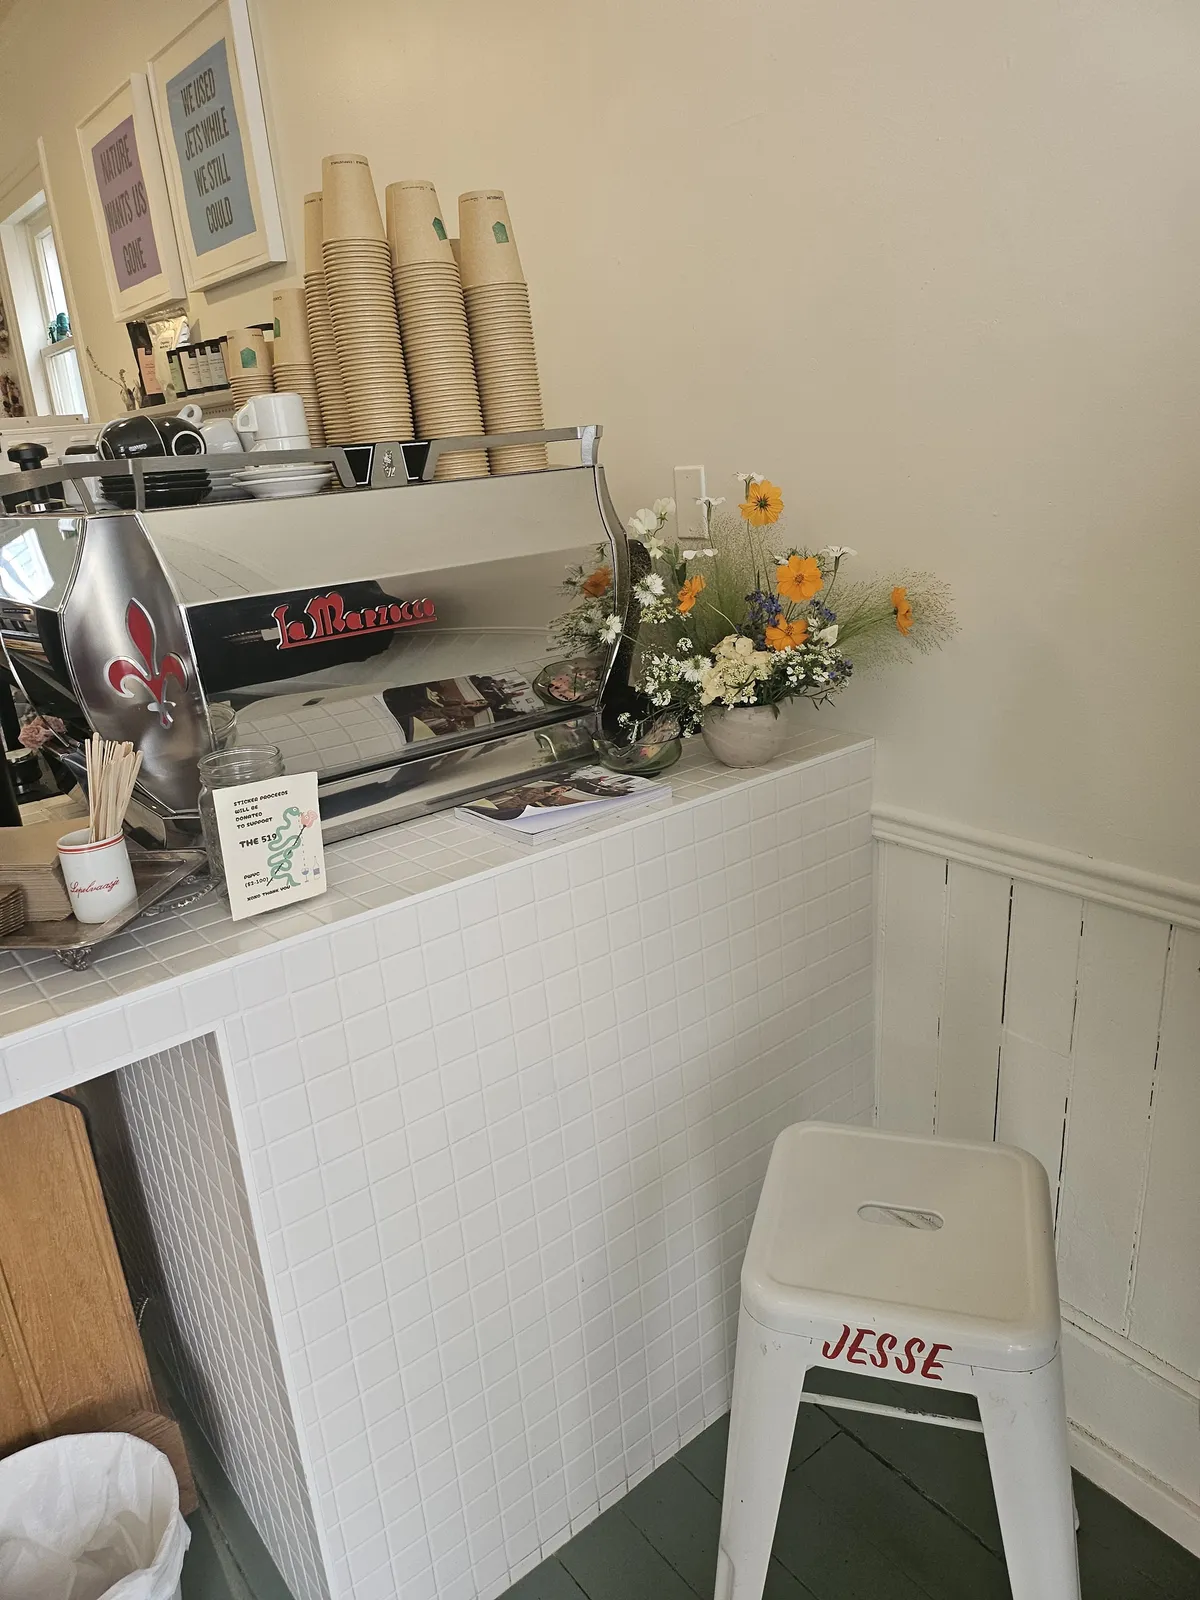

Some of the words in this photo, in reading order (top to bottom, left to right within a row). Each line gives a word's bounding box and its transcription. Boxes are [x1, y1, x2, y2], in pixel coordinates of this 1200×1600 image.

[180, 83, 195, 118] WE
[193, 67, 216, 108] USED
[184, 124, 204, 161] JETS
[200, 105, 230, 150] WHILE
[100, 134, 133, 185] NATURE
[194, 164, 208, 197] WE
[206, 152, 231, 193] STILL
[104, 192, 133, 235] WANTS
[132, 180, 148, 217] US
[205, 196, 234, 234] COULD
[122, 237, 147, 276] GONE
[271, 603, 308, 650] La
[304, 591, 436, 639] Marzocco
[234, 797, 258, 806] STICKER
[260, 790, 288, 801] PROCEEDS
[235, 811, 263, 822] DONATED
[239, 837, 259, 849] THE
[261, 833, 277, 843] 519
[246, 816, 273, 828] SUPPORT
[262, 888, 279, 898] THANK
[822, 1323, 953, 1381] JESSE
